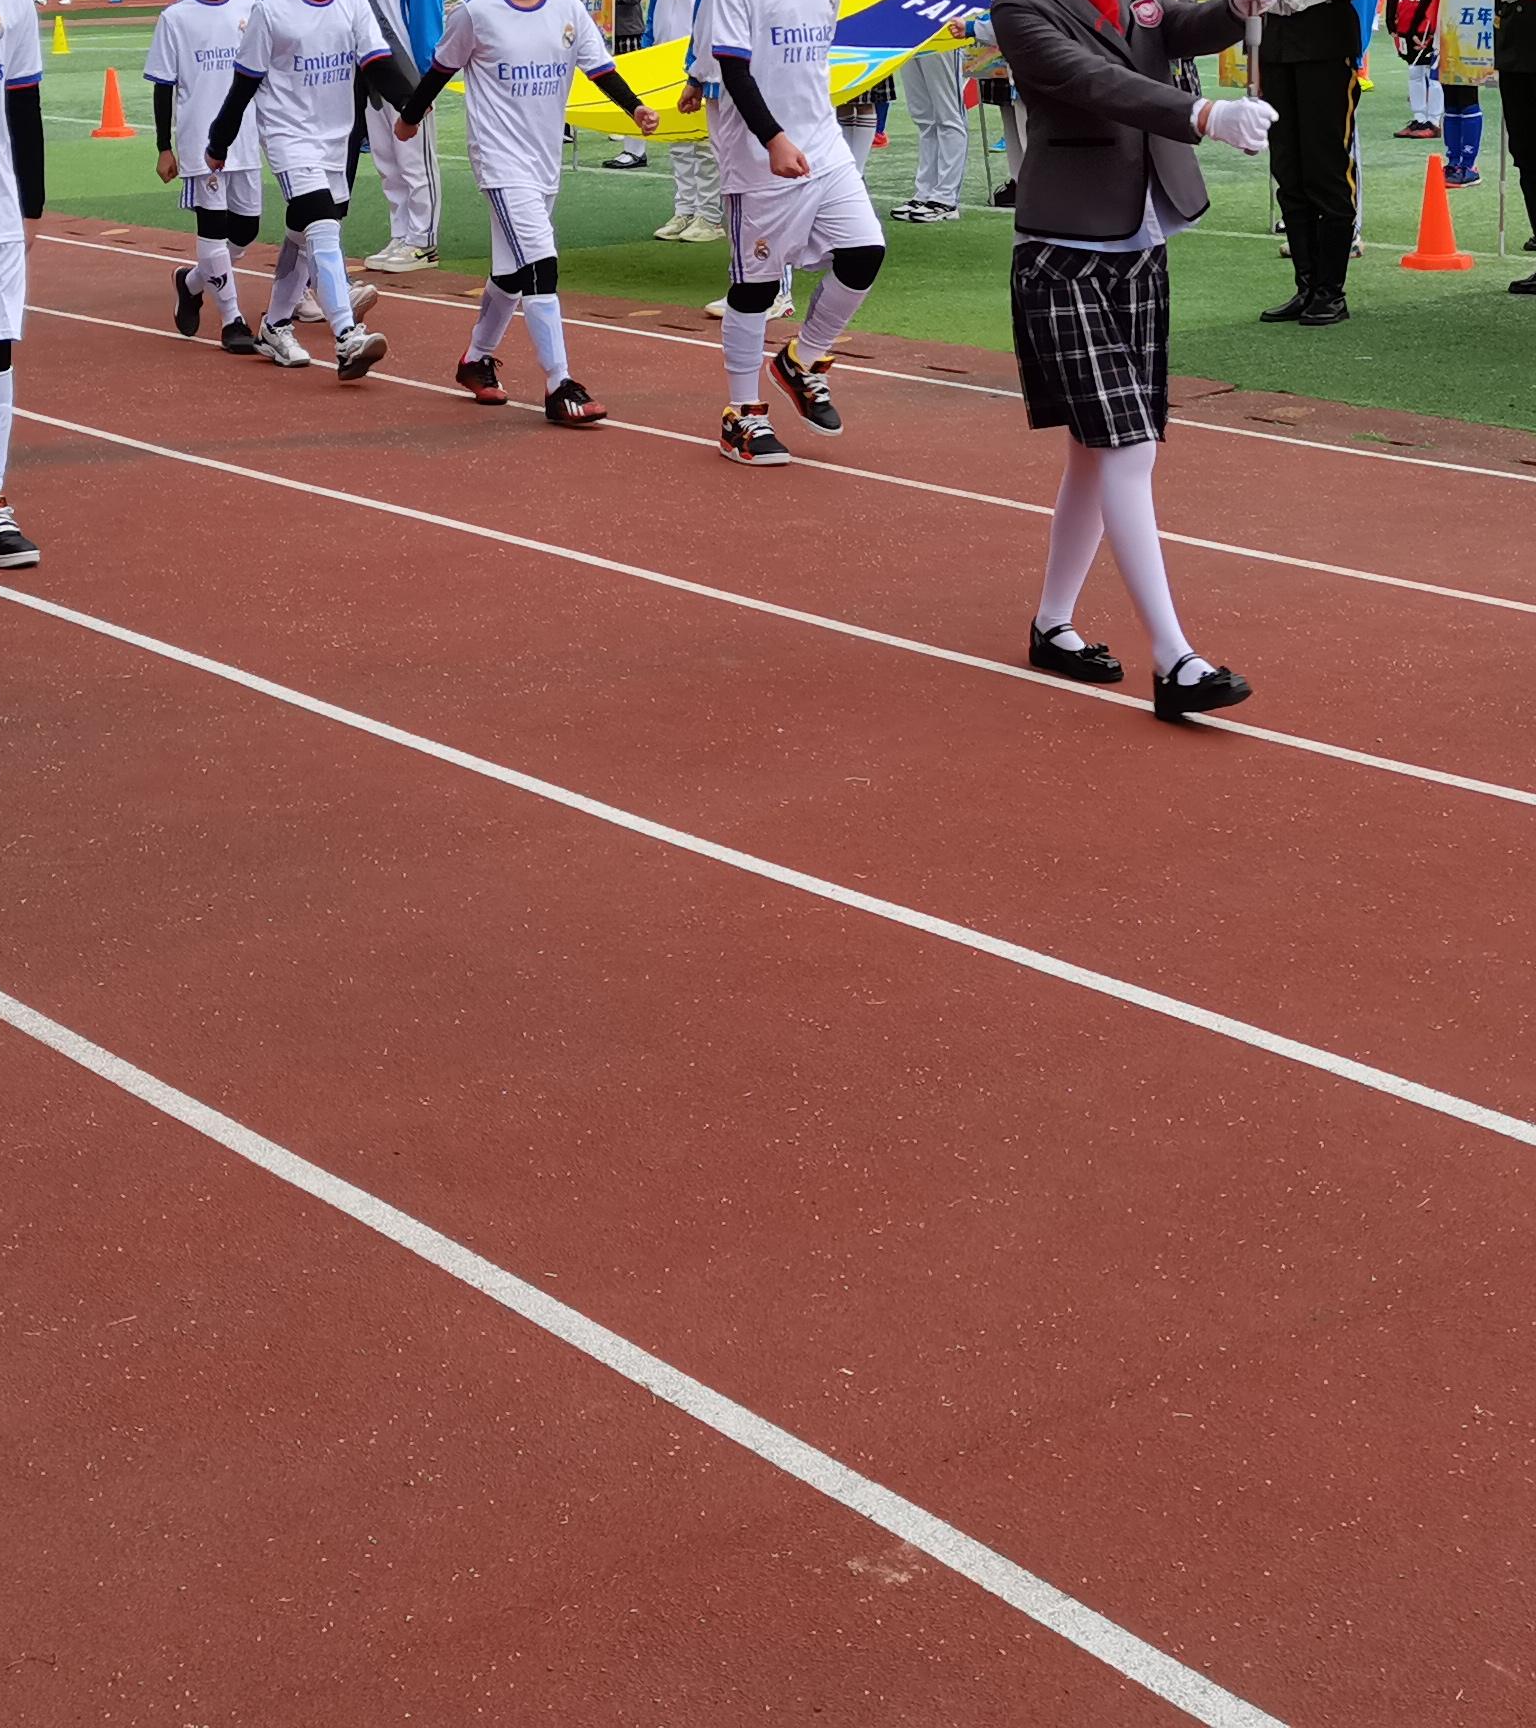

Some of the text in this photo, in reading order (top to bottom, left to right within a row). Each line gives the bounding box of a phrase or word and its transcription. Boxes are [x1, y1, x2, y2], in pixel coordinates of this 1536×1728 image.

[770, 23, 832, 46] Emirate
[784, 47, 802, 64] FLY
[303, 72, 319, 87] FLY
[511, 82, 528, 97] FLY
